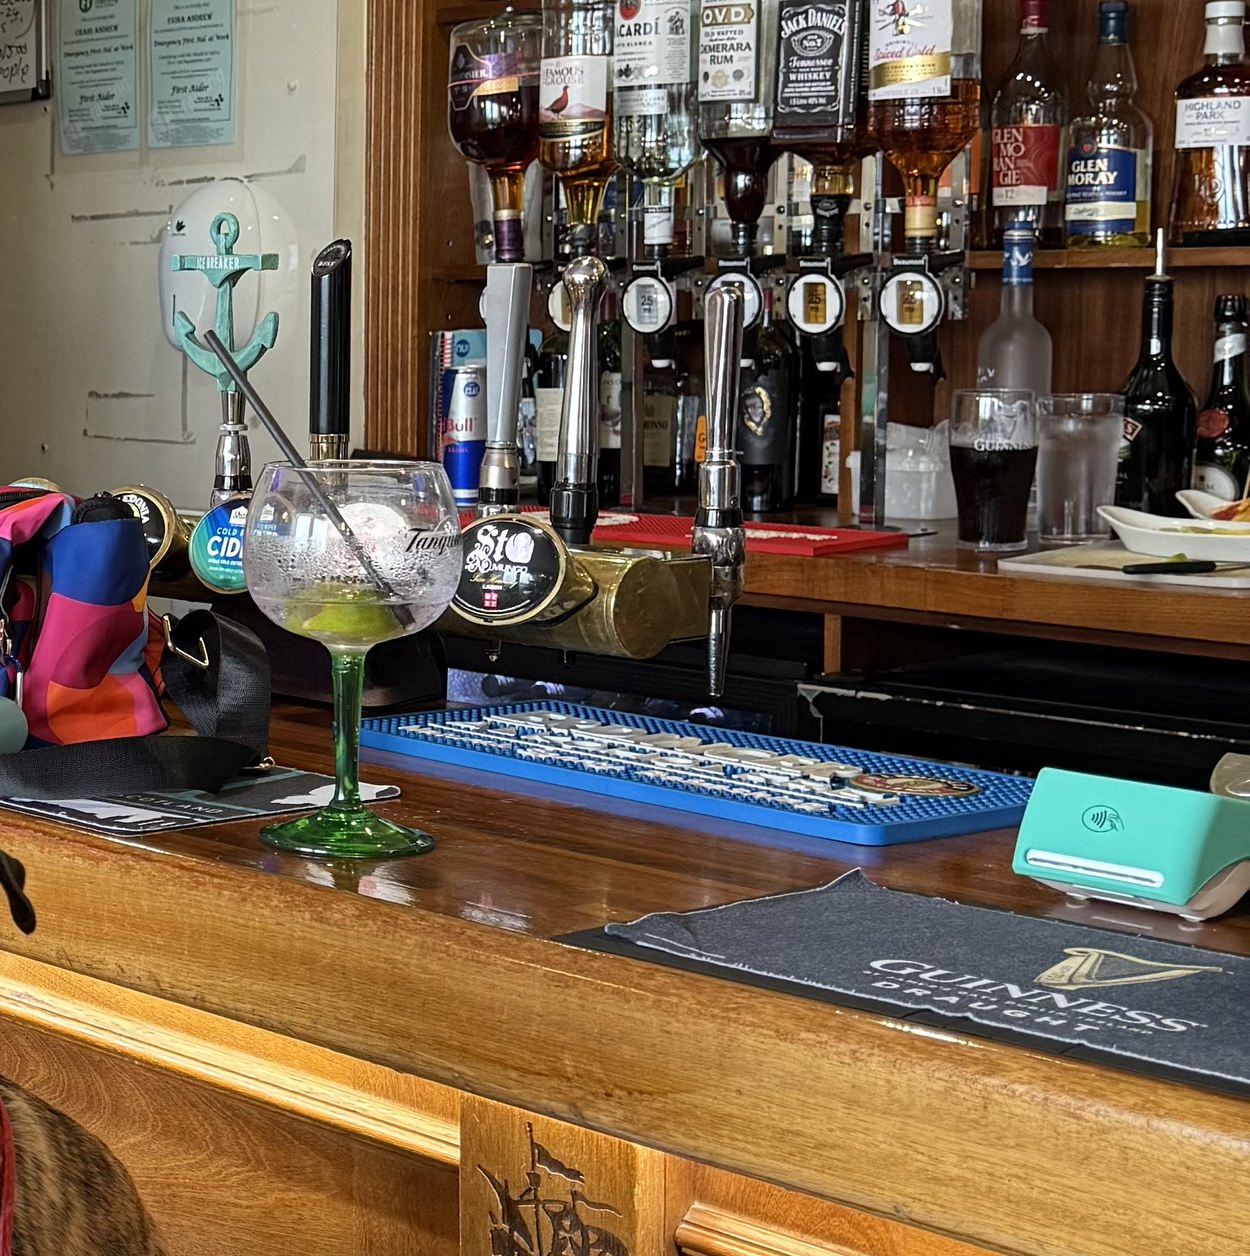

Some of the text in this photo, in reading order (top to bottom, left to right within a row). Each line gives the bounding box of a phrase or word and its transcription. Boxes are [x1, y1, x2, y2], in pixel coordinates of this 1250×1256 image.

[617, 17, 661, 38] CARDÍ
[781, 13, 807, 38] JACK
[710, 54, 734, 65] RUM
[789, 56, 833, 68] Tennessee
[789, 71, 832, 80] WHISKEY
[1185, 100, 1241, 111] HIGHLAND
[1196, 111, 1225, 120] PARK
[1071, 158, 1108, 172] GLEN
[1067, 171, 1118, 186] MORAY
[447, 417, 473, 432] Bull
[121, 494, 150, 524] EDONIA
[217, 527, 238, 536] COLD
[207, 535, 244, 558] CID
[869, 959, 1199, 1032] GUINNESS
[871, 981, 1101, 1032] DRAUGHT
[1076, 1015, 1154, 1035] IRELAND
